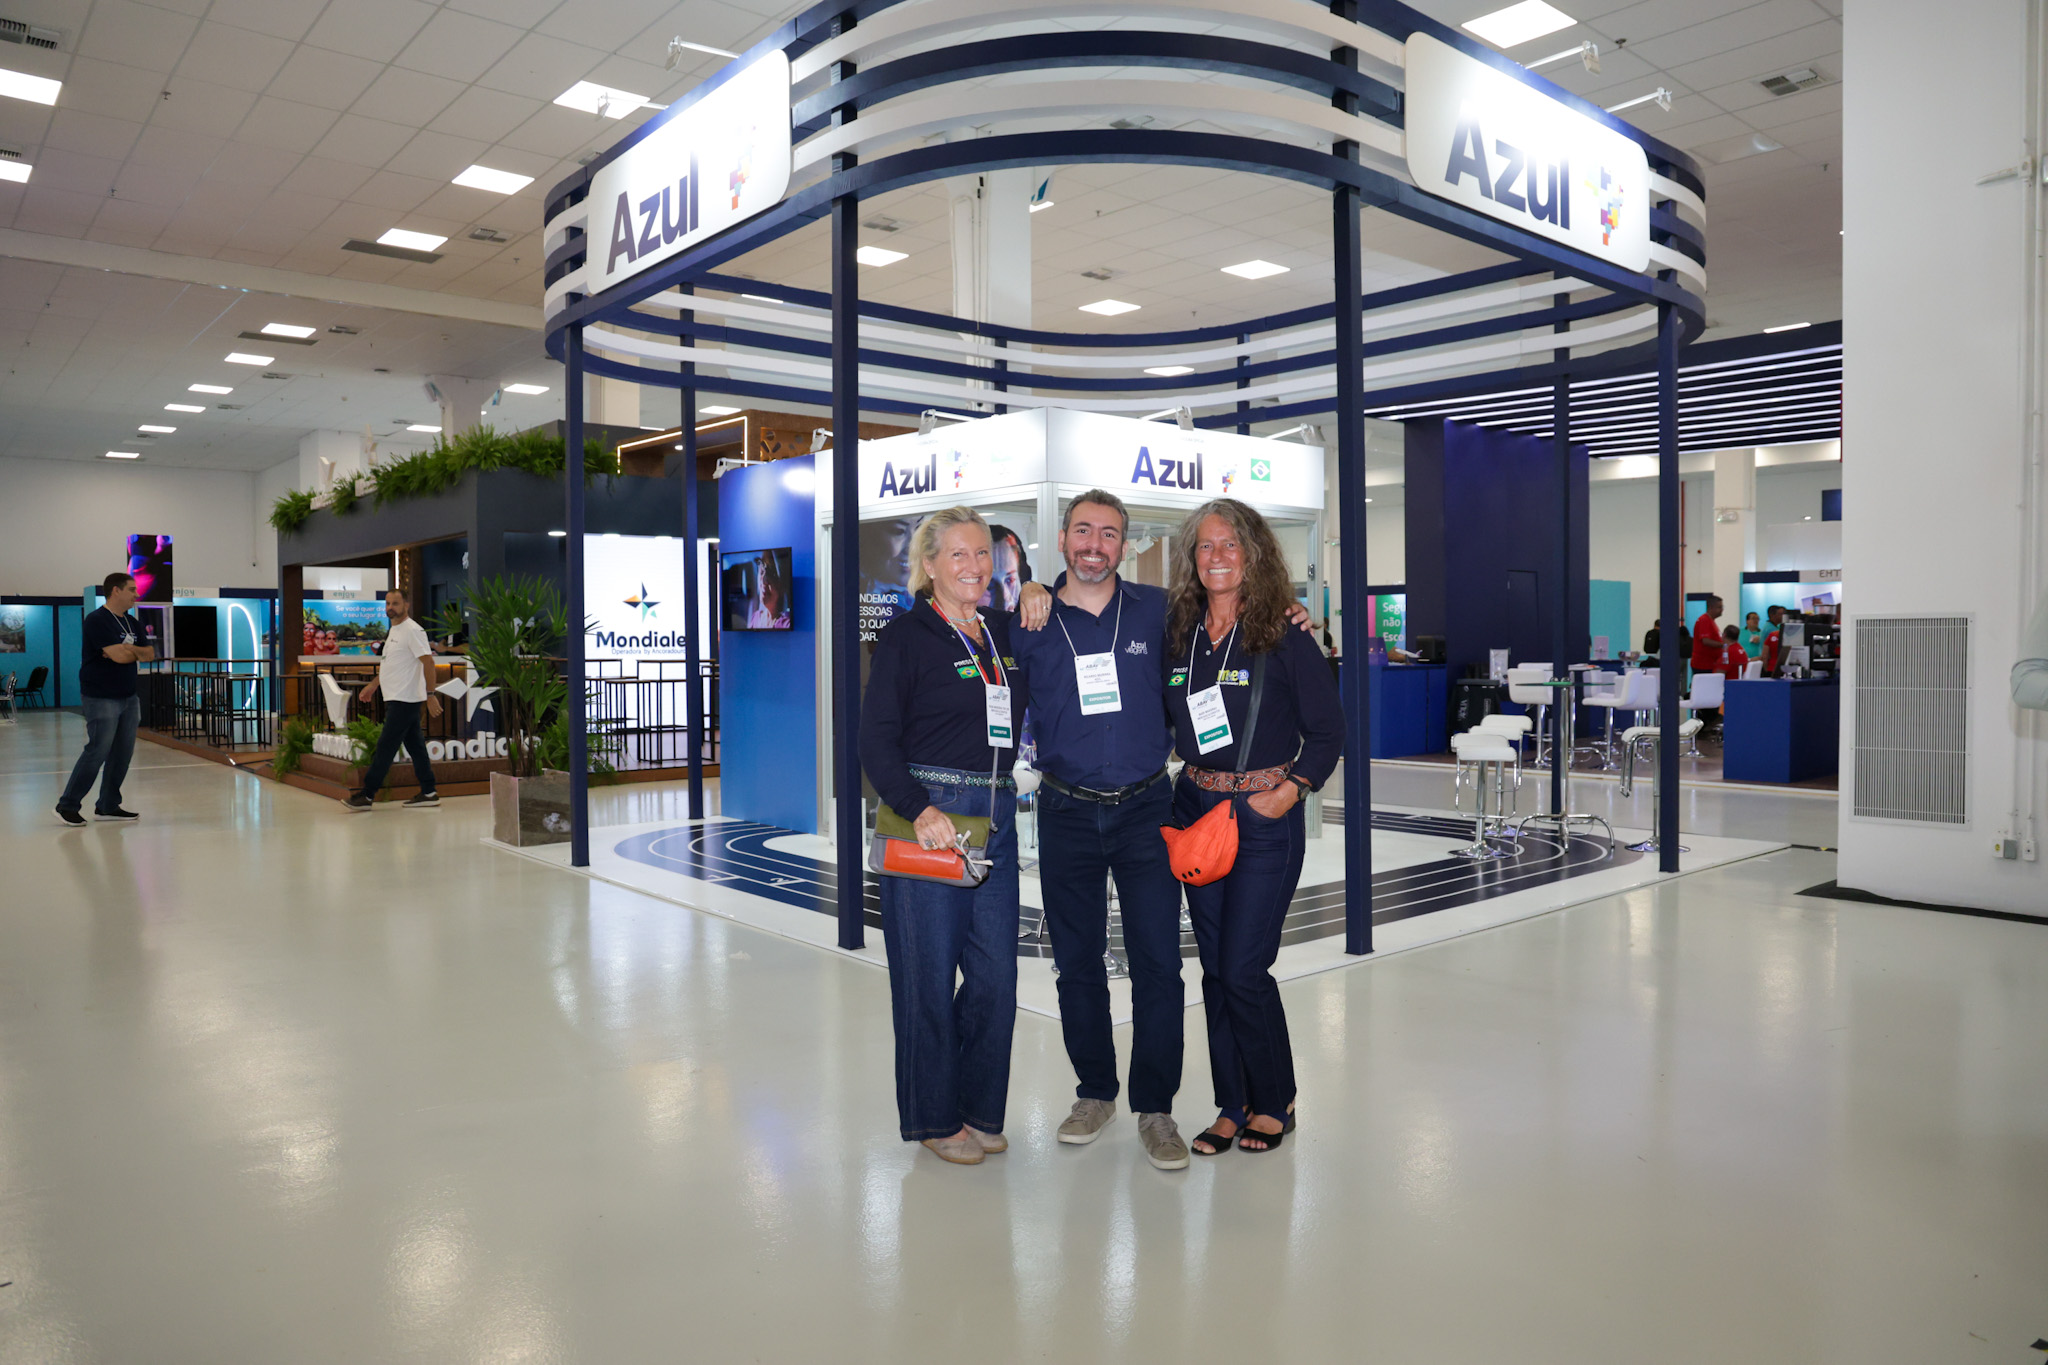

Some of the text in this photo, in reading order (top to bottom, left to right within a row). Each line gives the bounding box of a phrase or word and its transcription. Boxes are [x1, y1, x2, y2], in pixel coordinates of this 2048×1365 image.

[1444, 106, 1570, 231] Azul
[606, 146, 699, 275] Azul
[879, 453, 937, 498] Azul
[1131, 446, 1203, 491] Azul
[596, 631, 686, 648] Mondiale
